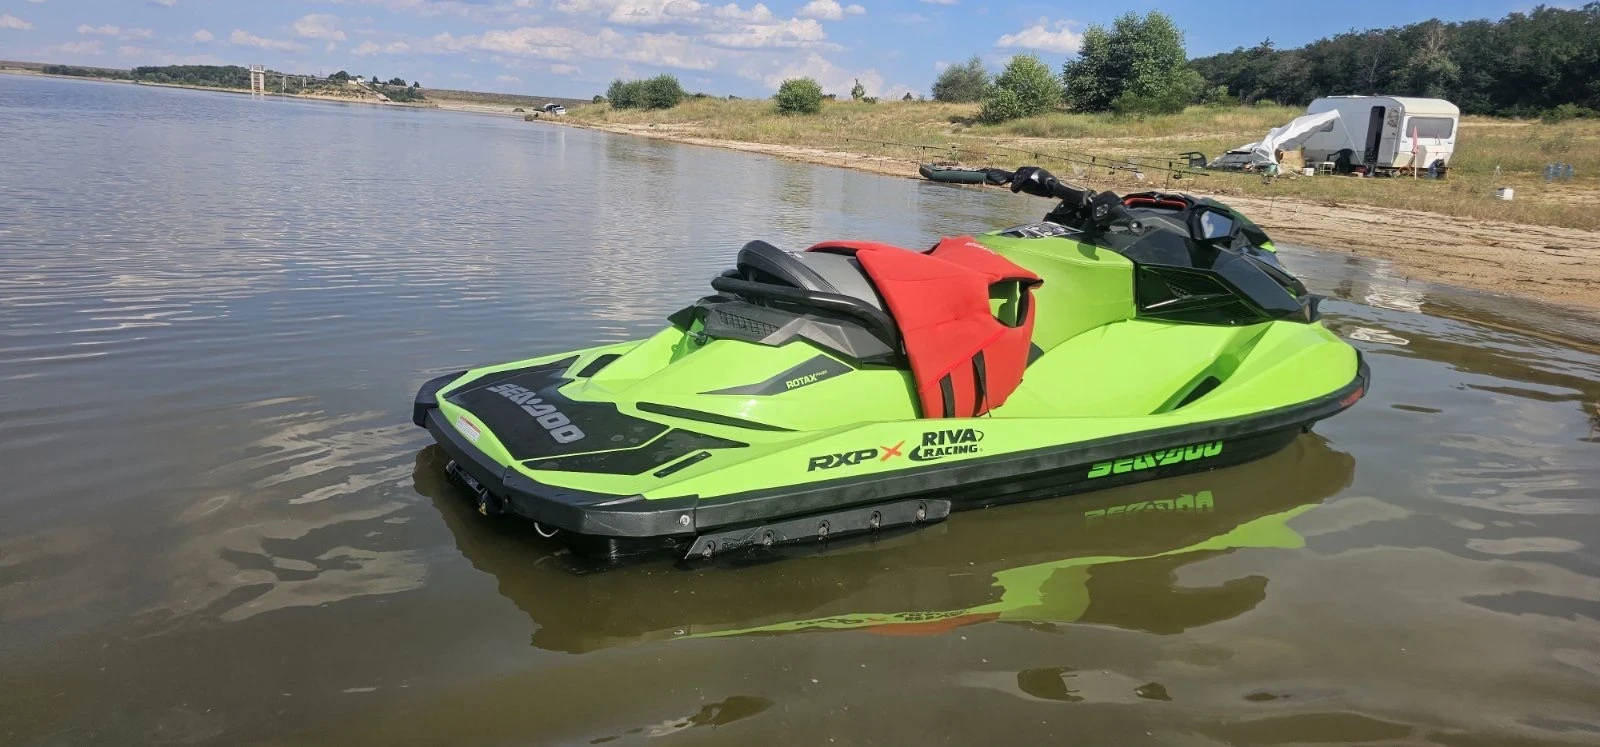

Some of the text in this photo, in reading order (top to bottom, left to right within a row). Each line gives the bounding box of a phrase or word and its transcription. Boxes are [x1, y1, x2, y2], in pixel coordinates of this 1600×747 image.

[785, 374, 818, 389] ROTAX
[922, 428, 977, 447] RIVA
[923, 445, 977, 458] RACING
